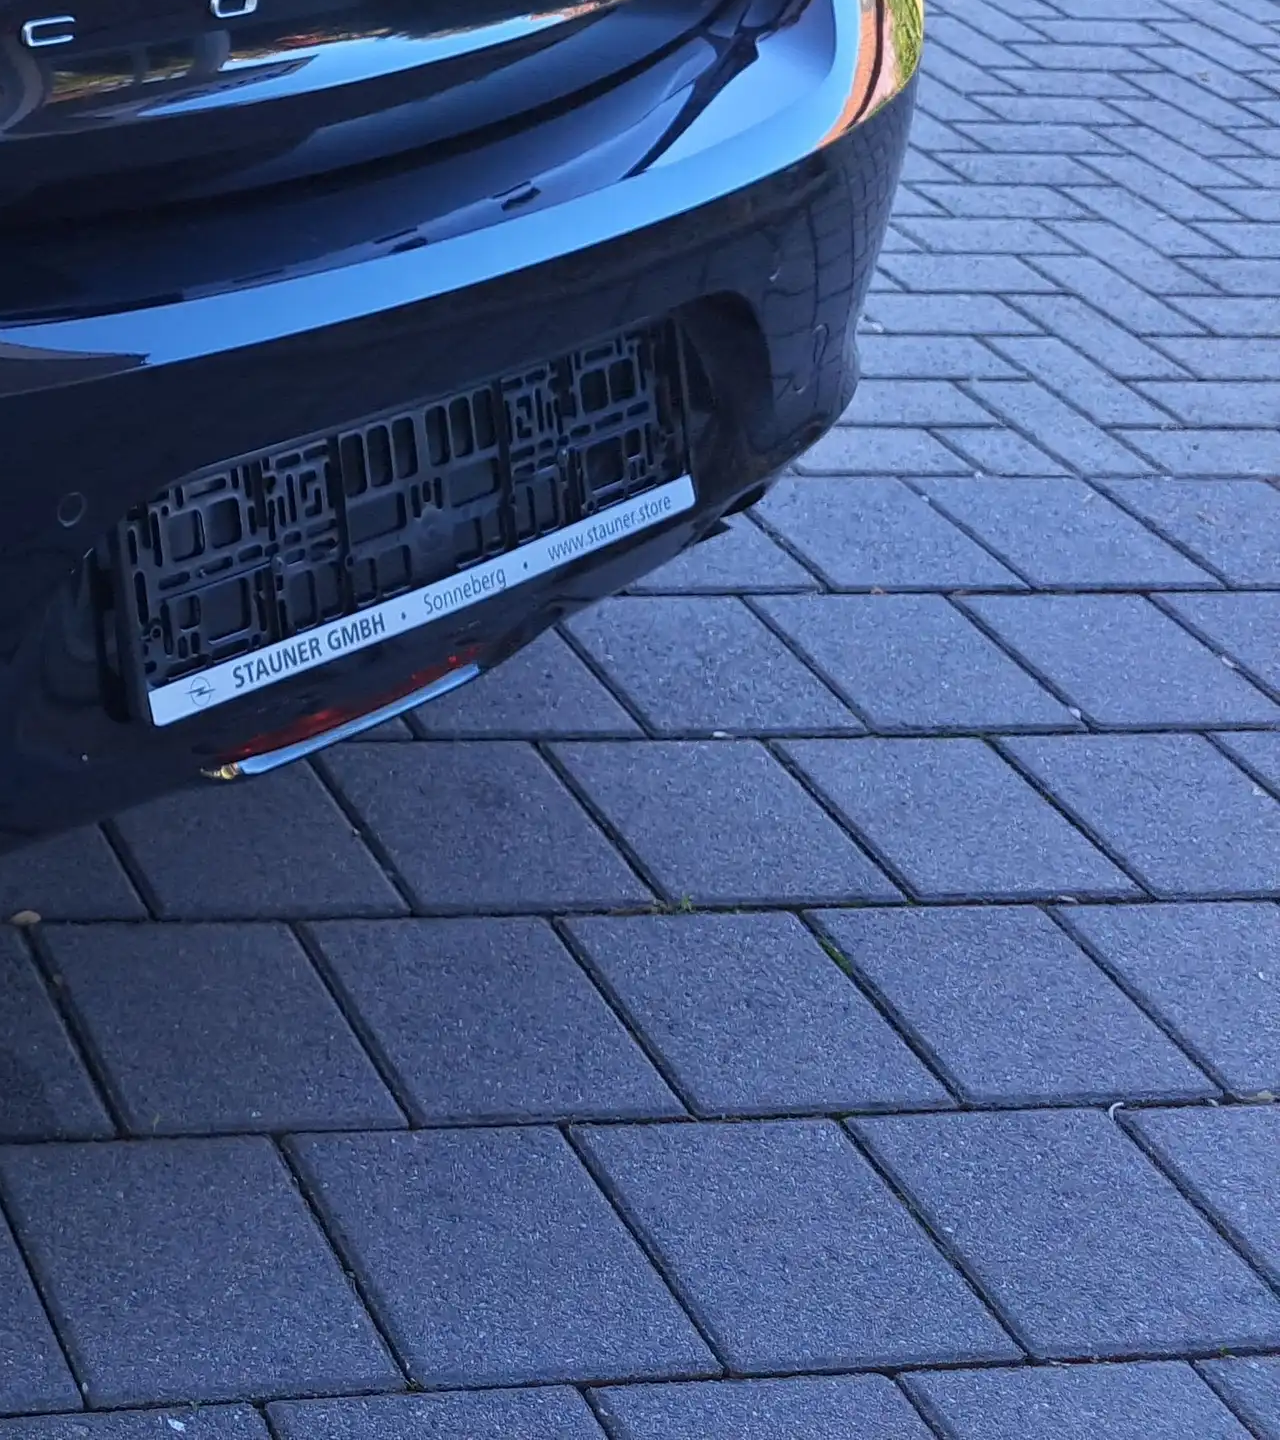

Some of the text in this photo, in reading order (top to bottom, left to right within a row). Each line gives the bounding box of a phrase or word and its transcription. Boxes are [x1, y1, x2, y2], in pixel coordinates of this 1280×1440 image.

[232, 494, 672, 689] STAUNER GMBH Sonneberg www.stauner.store
